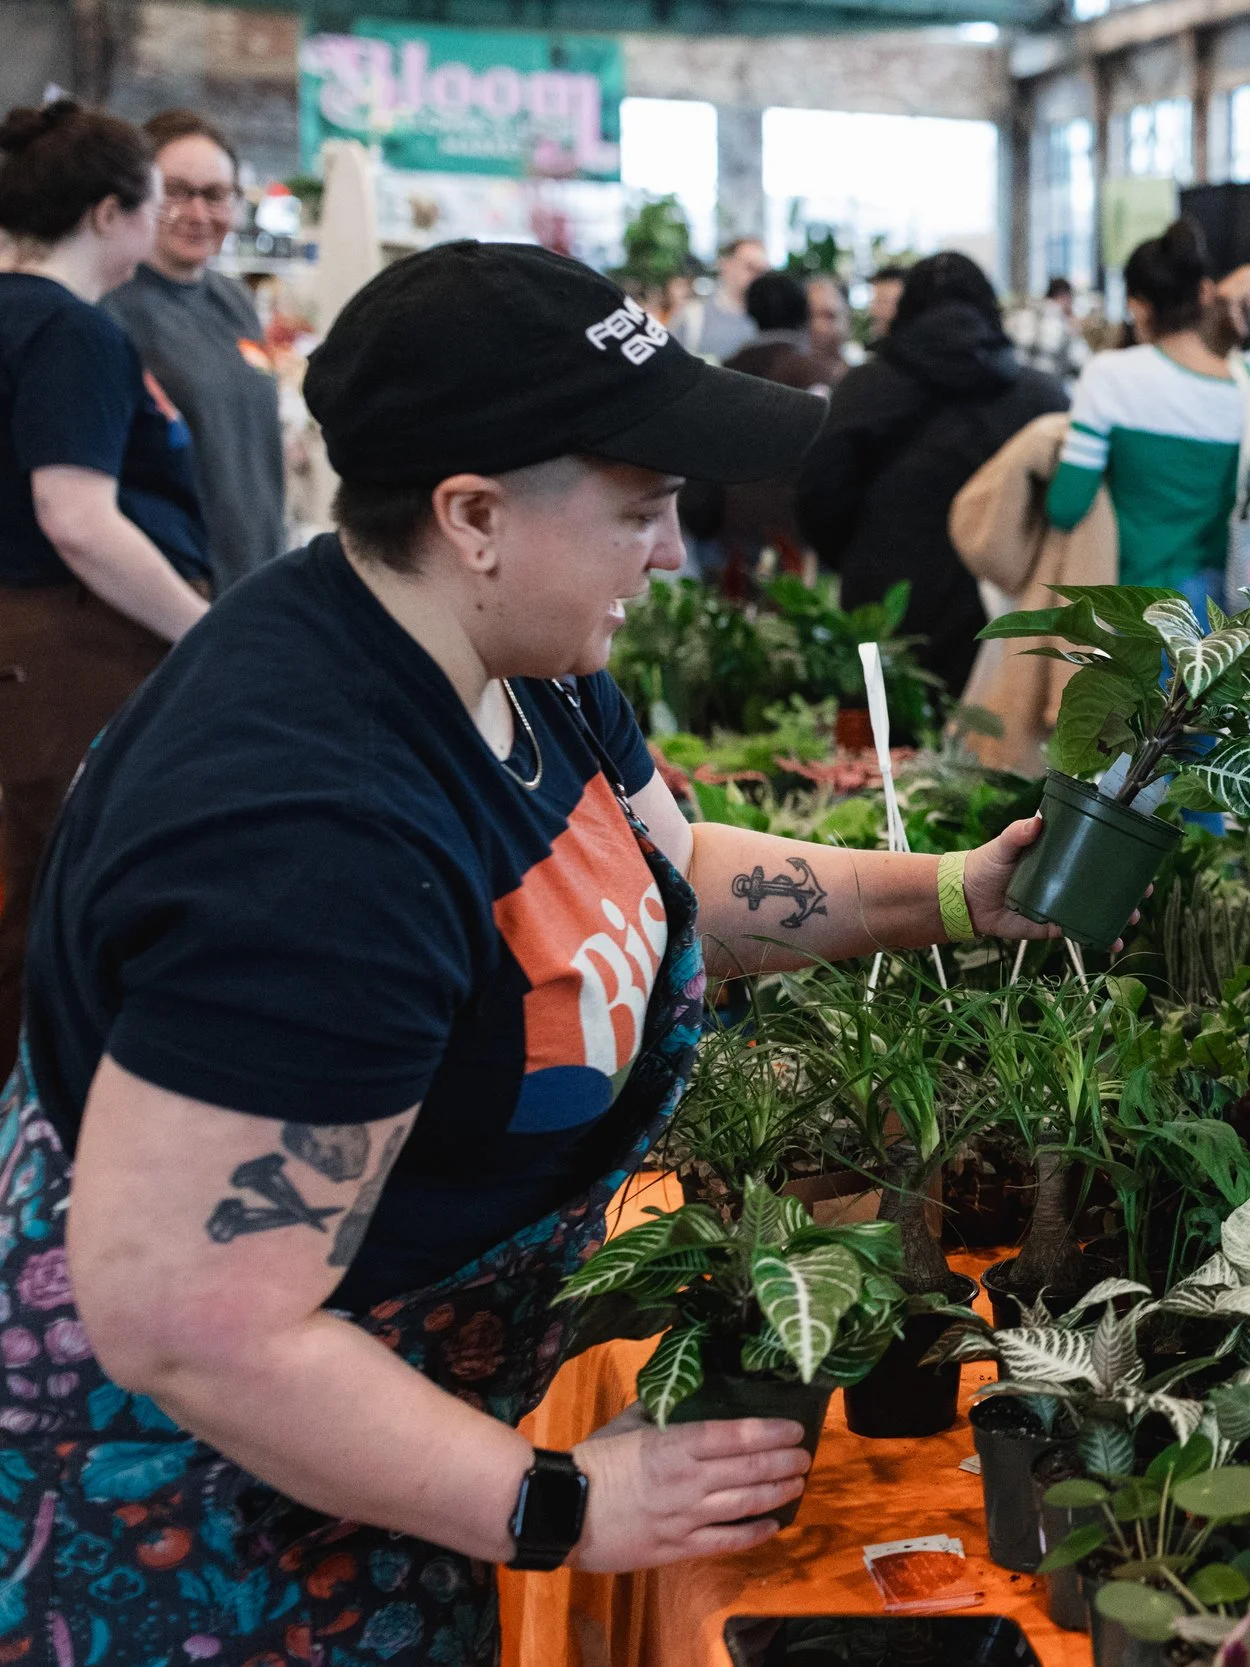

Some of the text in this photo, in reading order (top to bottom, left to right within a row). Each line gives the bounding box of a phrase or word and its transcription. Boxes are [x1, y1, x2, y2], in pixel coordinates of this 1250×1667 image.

[299, 33, 618, 173] Bloom
[585, 295, 645, 350] FEM
[620, 312, 669, 365] ENE
